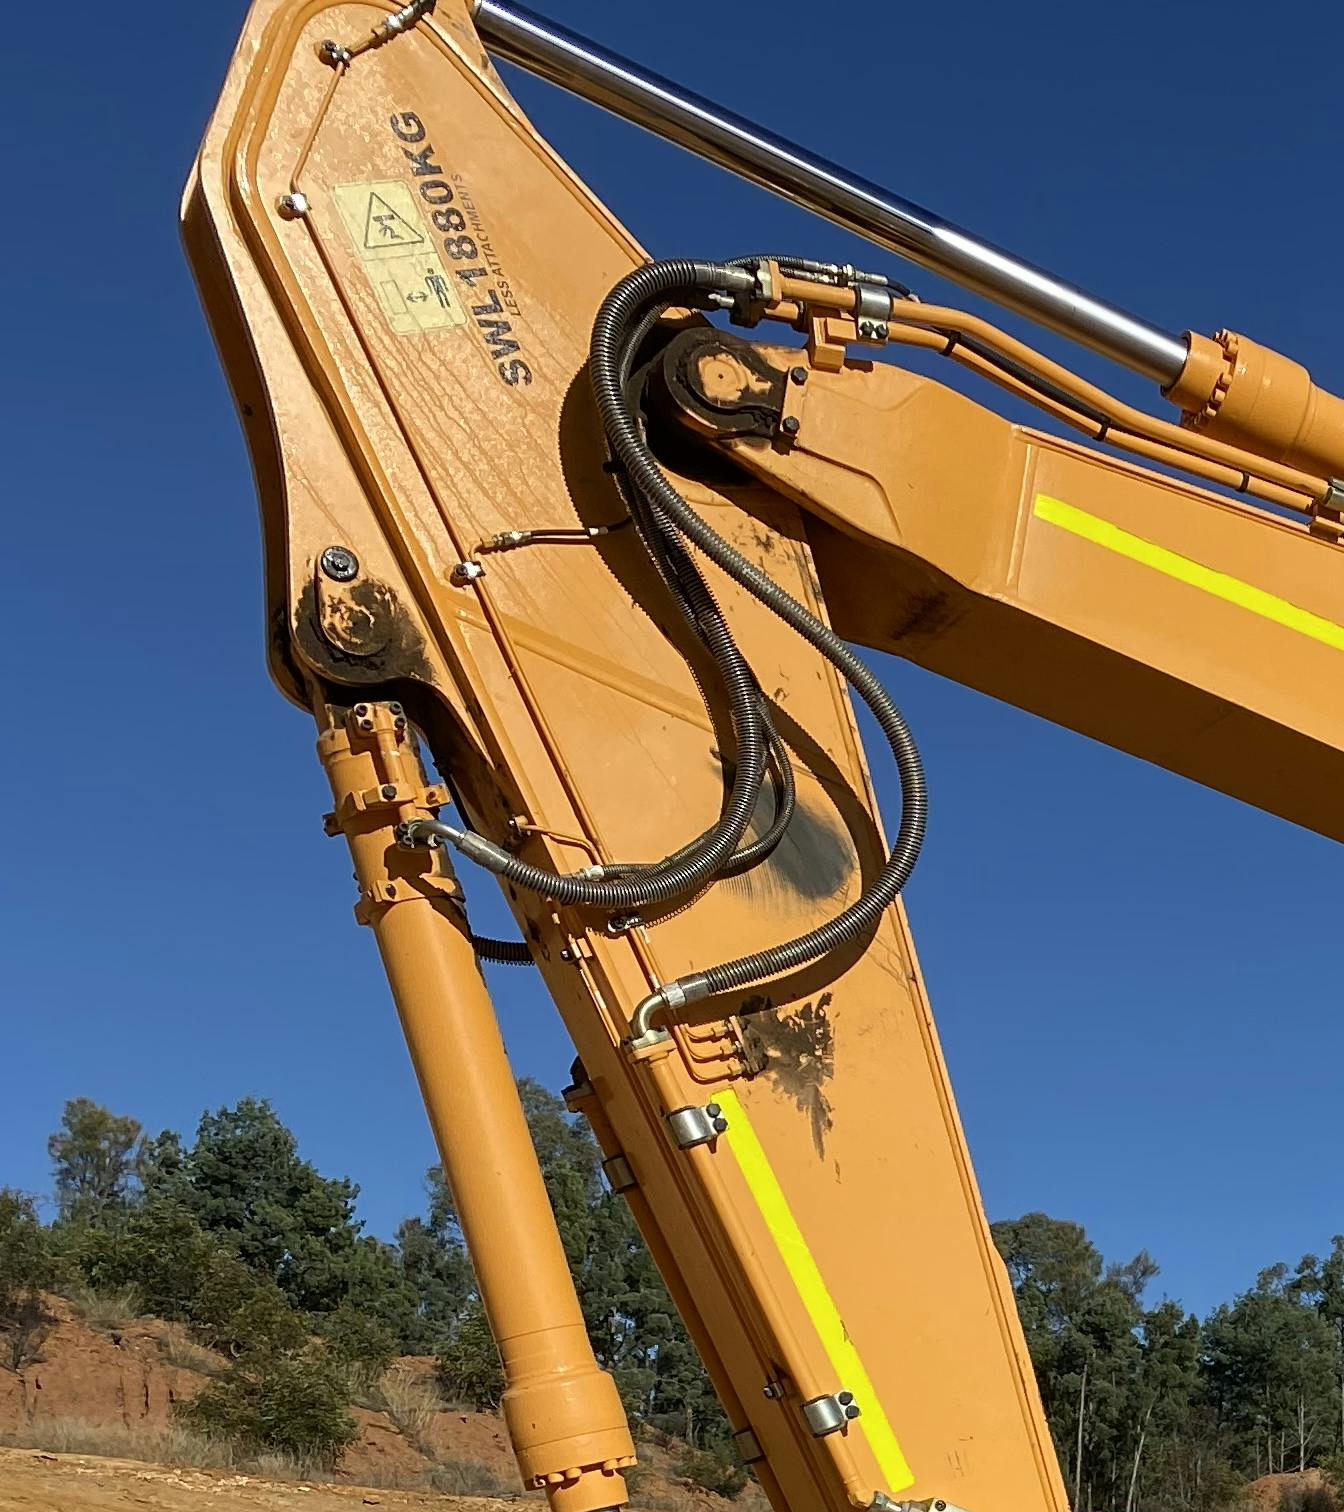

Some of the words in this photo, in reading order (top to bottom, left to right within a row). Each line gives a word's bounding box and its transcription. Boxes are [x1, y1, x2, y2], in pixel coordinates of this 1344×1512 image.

[390, 111, 489, 288] 1880KG
[451, 173, 505, 278] ATTACHMENTS
[471, 289, 533, 387] SWL
[497, 280, 521, 317] LESS
